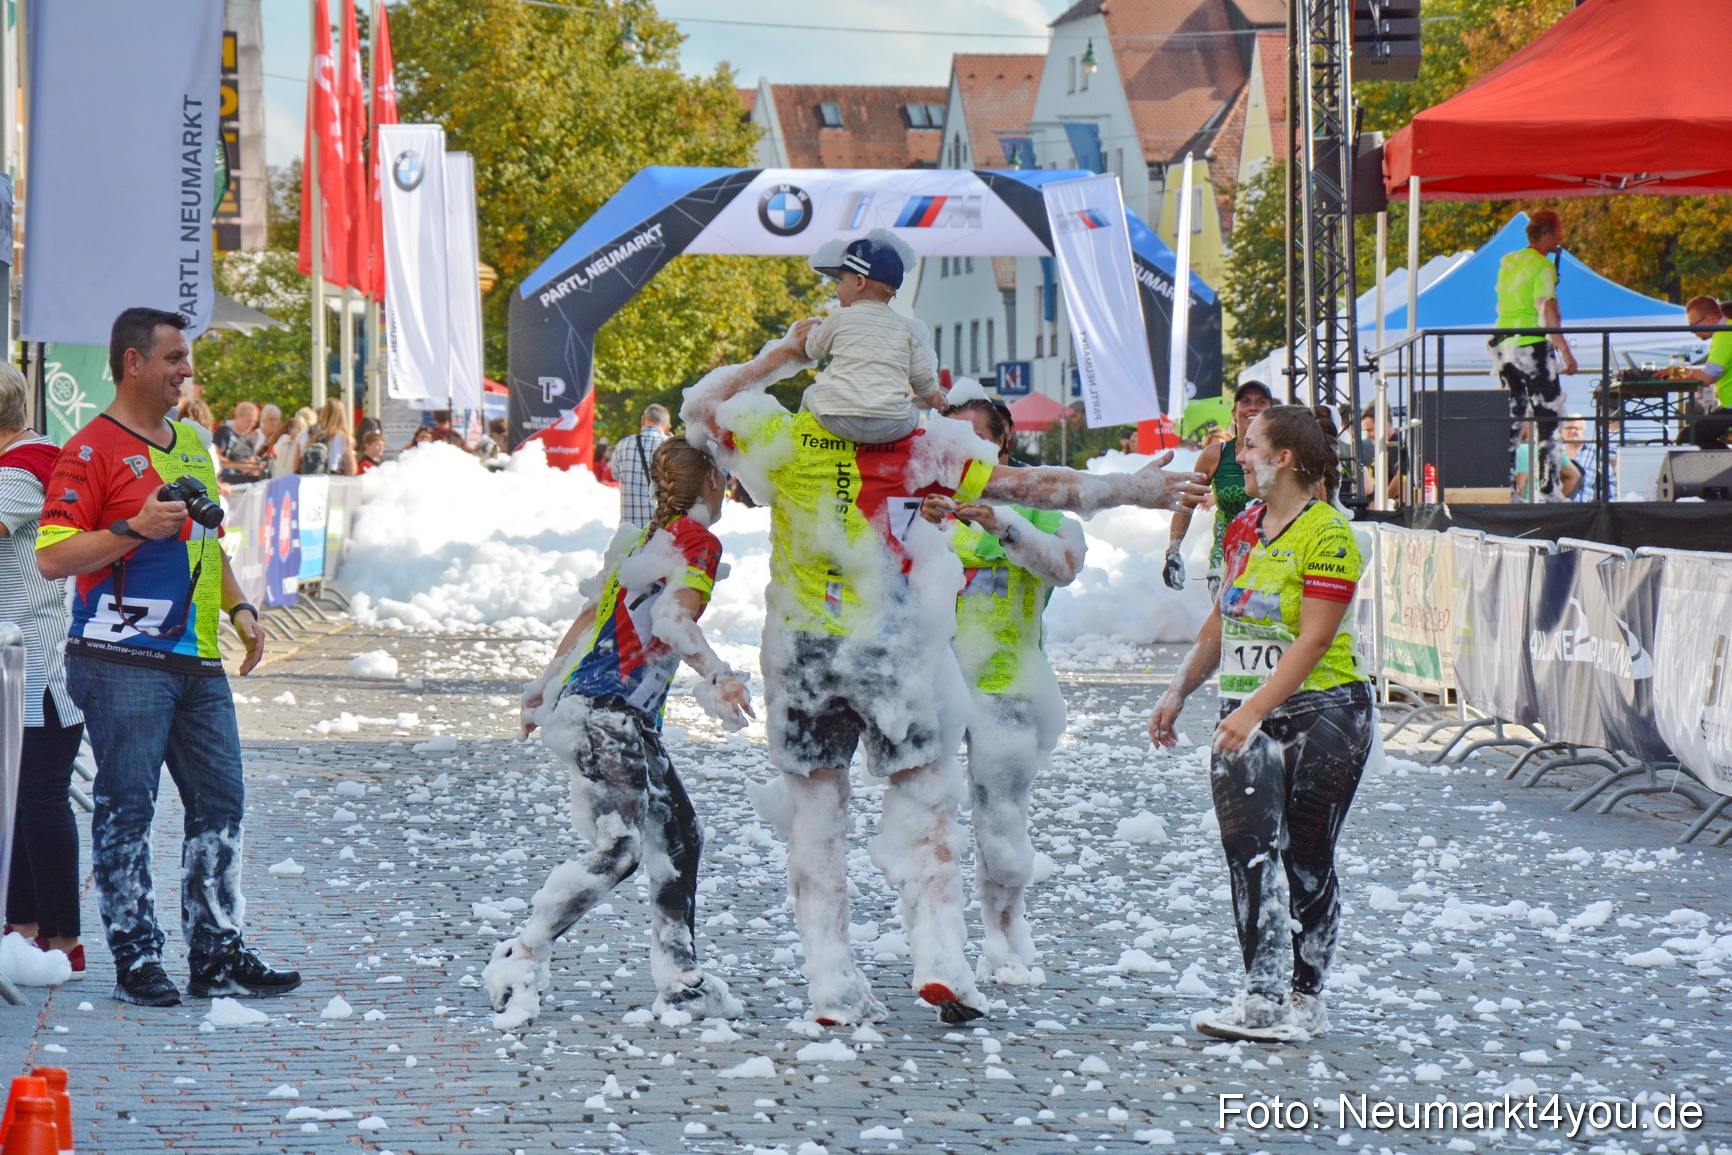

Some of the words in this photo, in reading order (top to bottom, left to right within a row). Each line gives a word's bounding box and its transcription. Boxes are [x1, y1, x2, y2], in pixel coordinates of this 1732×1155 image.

[179, 93, 203, 242] NEUMARKT
[538, 273, 588, 308] PARTL
[584, 222, 664, 281] NEUMARKT
[801, 434, 847, 451] Team
[1308, 562, 1335, 572] BMW
[1312, 580, 1348, 591] Motorsport
[107, 602, 149, 633] 7
[86, 640, 166, 660] www.bmw-partl.de
[1234, 645, 1283, 670] 170
